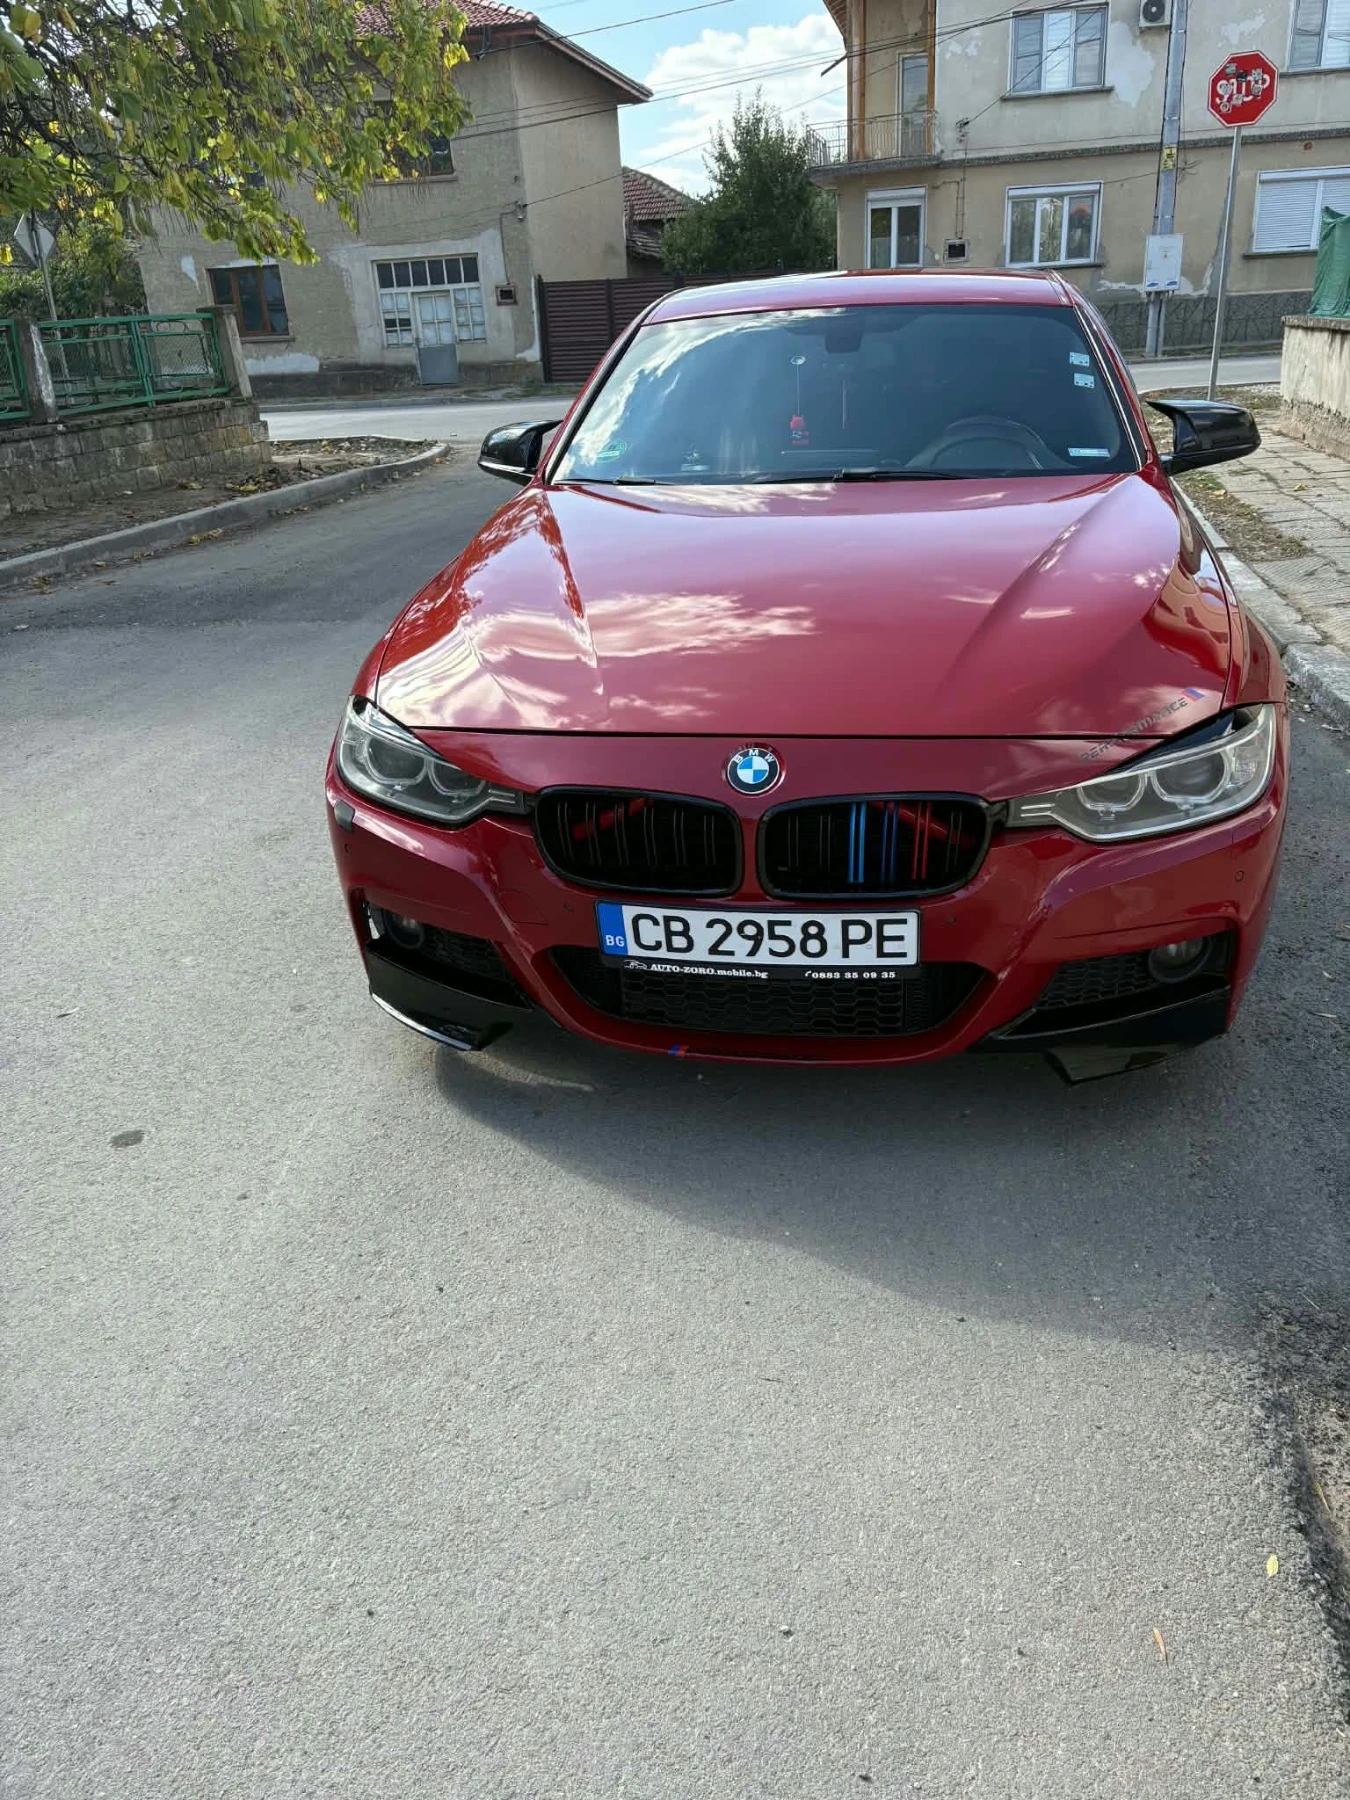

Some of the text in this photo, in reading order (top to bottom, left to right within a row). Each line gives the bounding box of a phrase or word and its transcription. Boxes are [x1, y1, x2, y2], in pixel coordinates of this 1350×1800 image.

[732, 749, 775, 764] BMW
[605, 934, 625, 947] BG
[631, 913, 908, 959] CB 2958 PE
[650, 963, 768, 979] AUTO-ZORO.mobile.bg
[881, 971, 895, 979] 35
